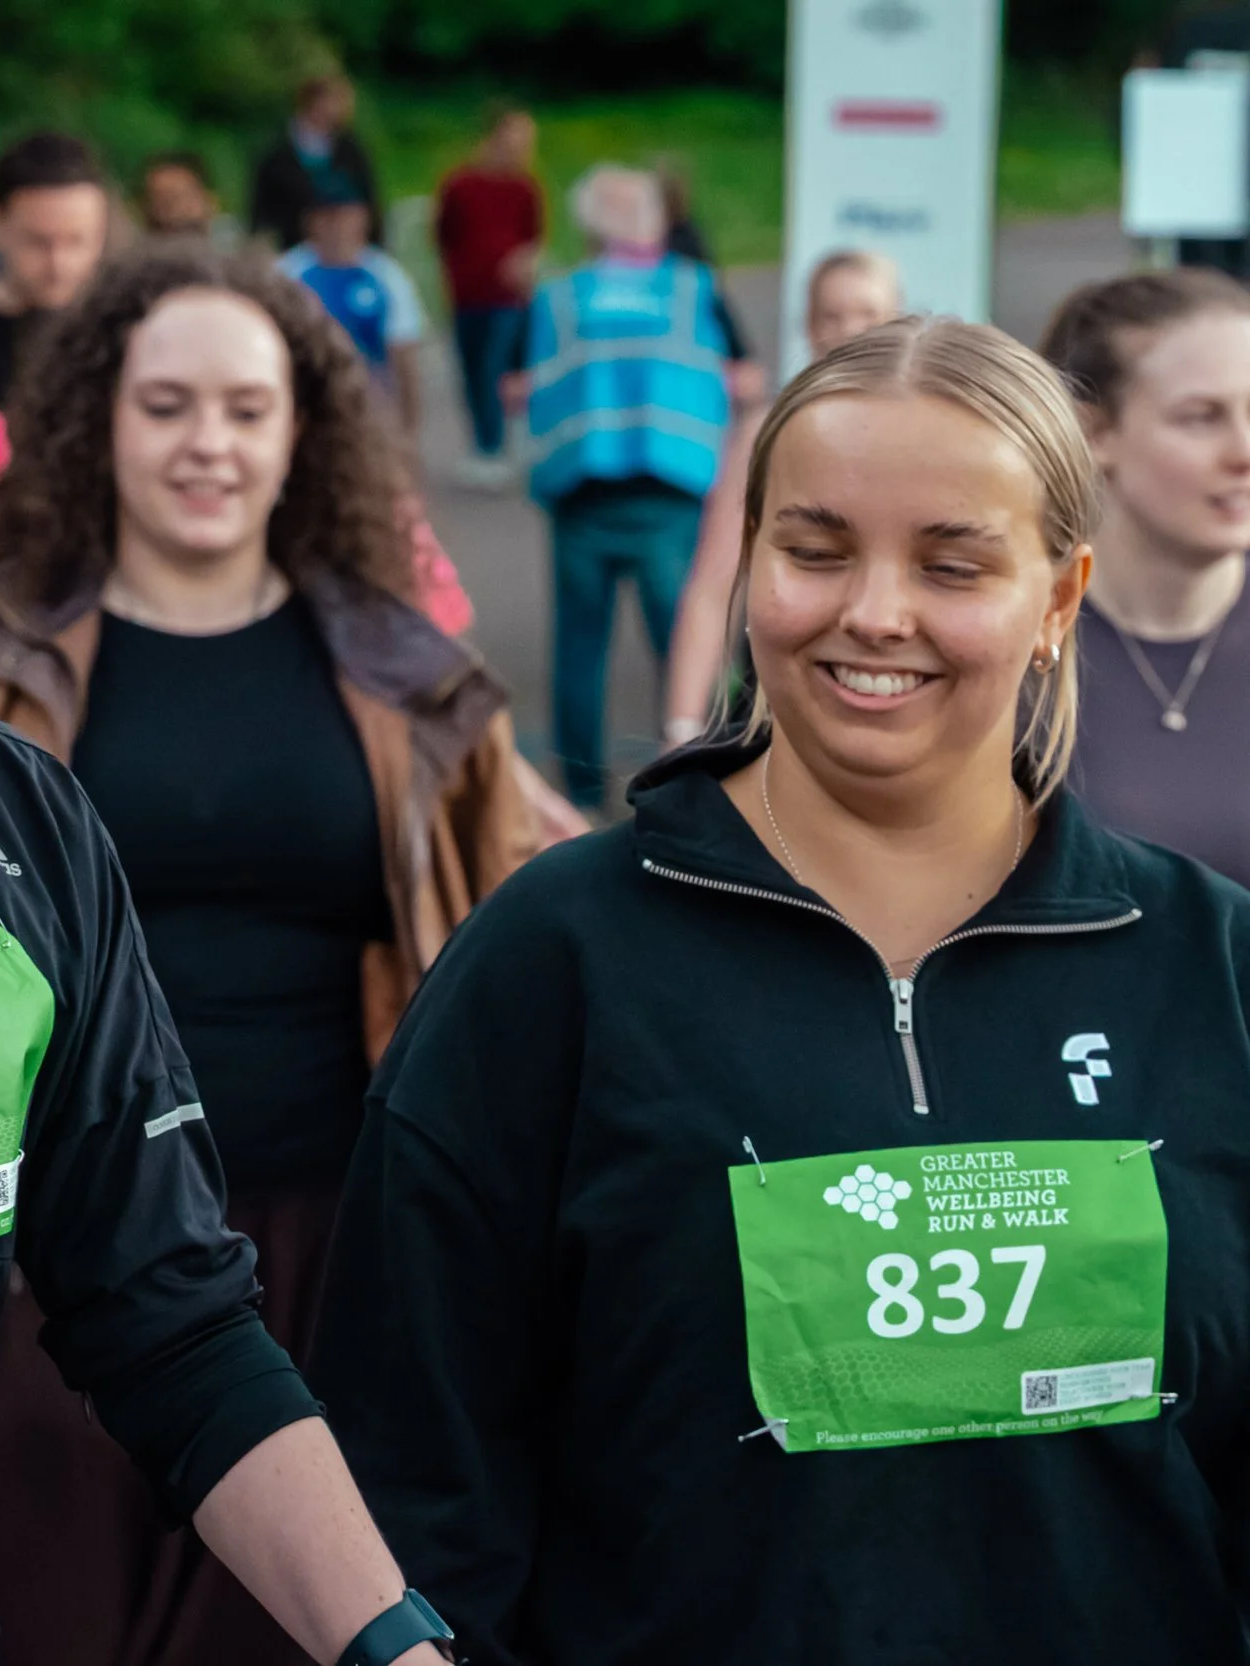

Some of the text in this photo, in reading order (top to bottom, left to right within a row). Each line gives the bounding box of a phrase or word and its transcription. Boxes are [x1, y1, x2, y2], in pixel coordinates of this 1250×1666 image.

[920, 1151, 1018, 1172] GREATER
[922, 1169, 1071, 1193] MANCHESTER
[926, 1190, 1057, 1212] WELLBEING
[927, 1208, 1070, 1233] RUN & WALK
[866, 1244, 1047, 1338] 837
[815, 1430, 858, 1445] Please
[861, 1427, 929, 1443] encourage
[931, 1425, 955, 1436] one
[958, 1420, 994, 1434] other
[995, 1418, 1040, 1436] person
[1041, 1416, 1058, 1428] on
[1060, 1411, 1080, 1425] the
